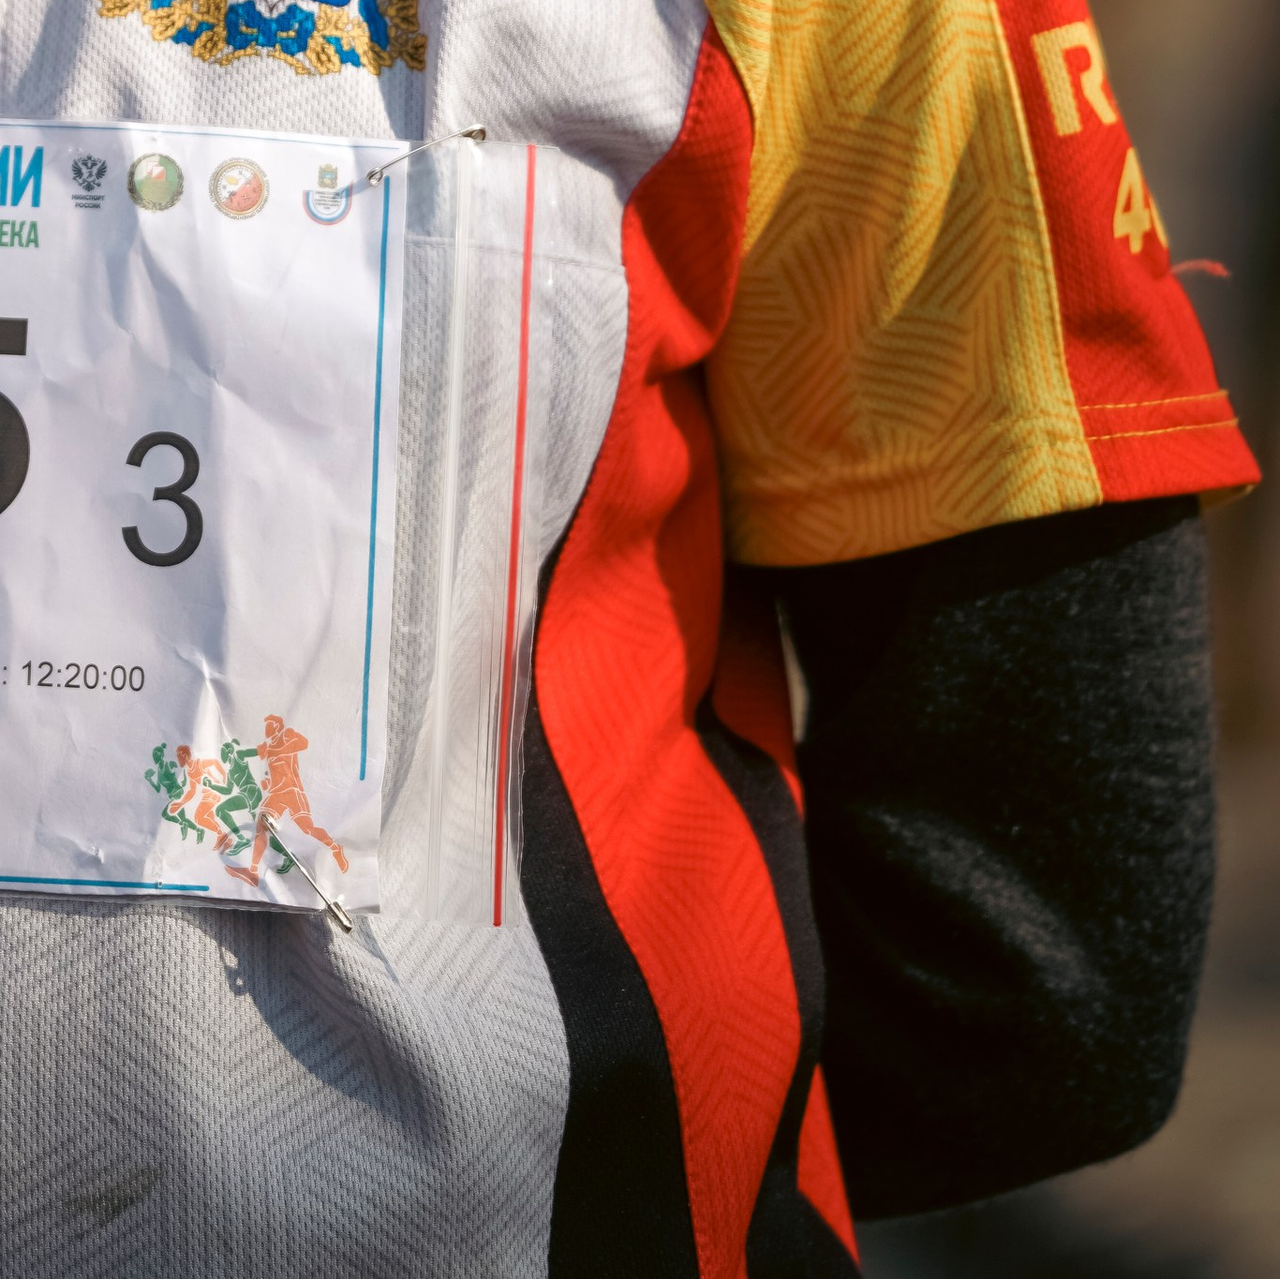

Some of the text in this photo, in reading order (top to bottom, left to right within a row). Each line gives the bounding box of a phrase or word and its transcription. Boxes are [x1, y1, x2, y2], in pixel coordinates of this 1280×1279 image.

[75, 202, 102, 210] РОССИИ
[1113, 146, 1169, 255] 4
[121, 430, 205, 568] 3
[21, 660, 146, 692] 12:20:00
